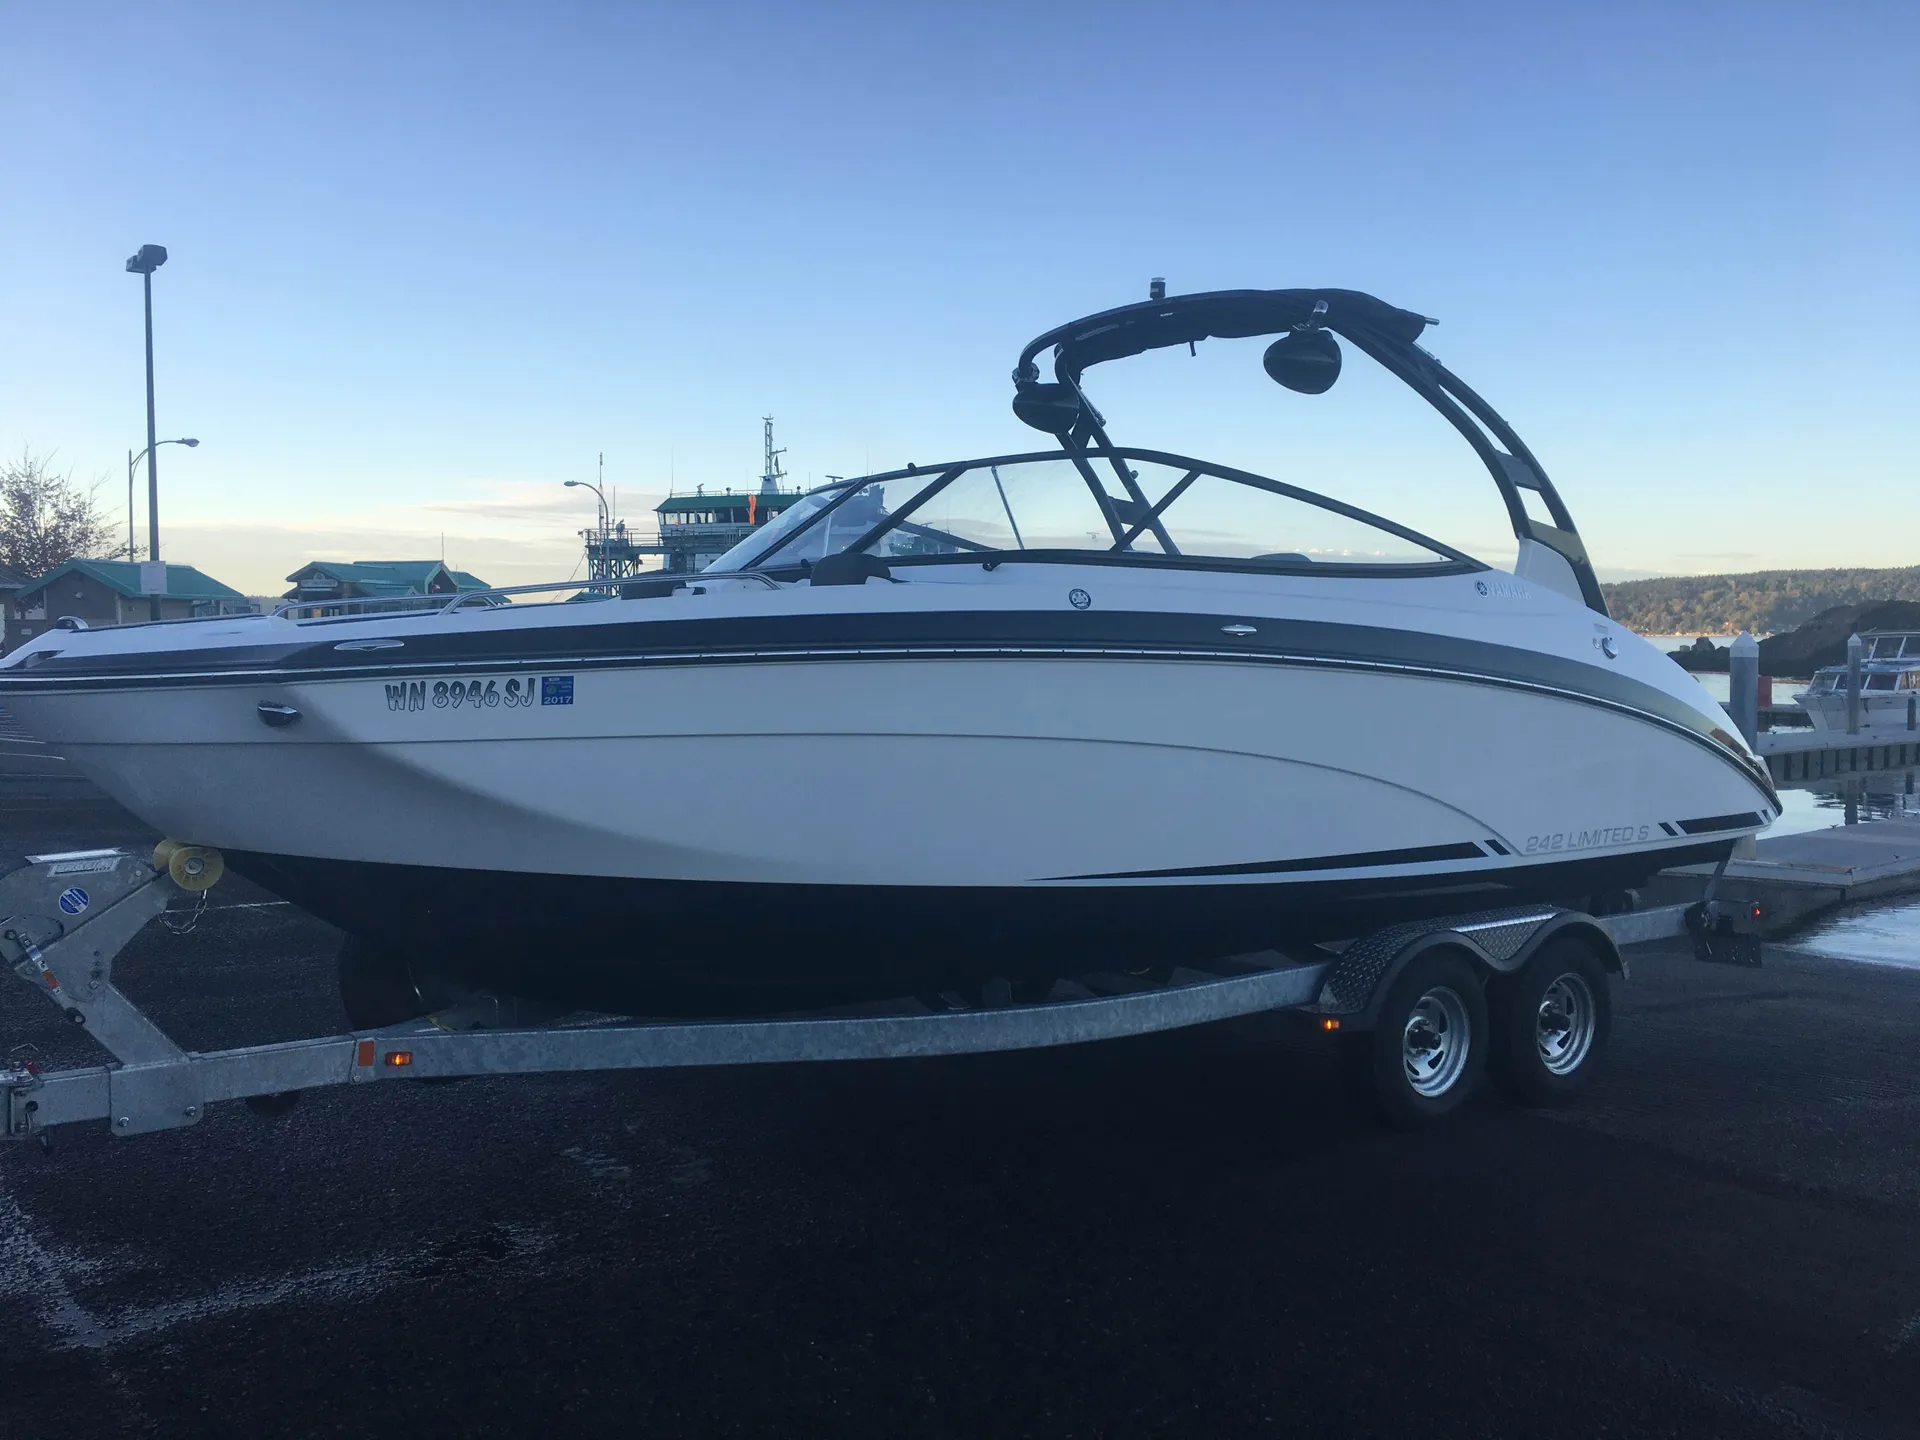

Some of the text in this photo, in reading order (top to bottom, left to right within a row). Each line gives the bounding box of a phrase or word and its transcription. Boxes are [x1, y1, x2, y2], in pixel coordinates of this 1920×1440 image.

[1486, 582, 1531, 600] YAMAHA
[384, 678, 536, 712] WN 8946 SJ
[543, 696, 572, 704] 2017
[1525, 825, 1650, 853] 242 LIMITED S
